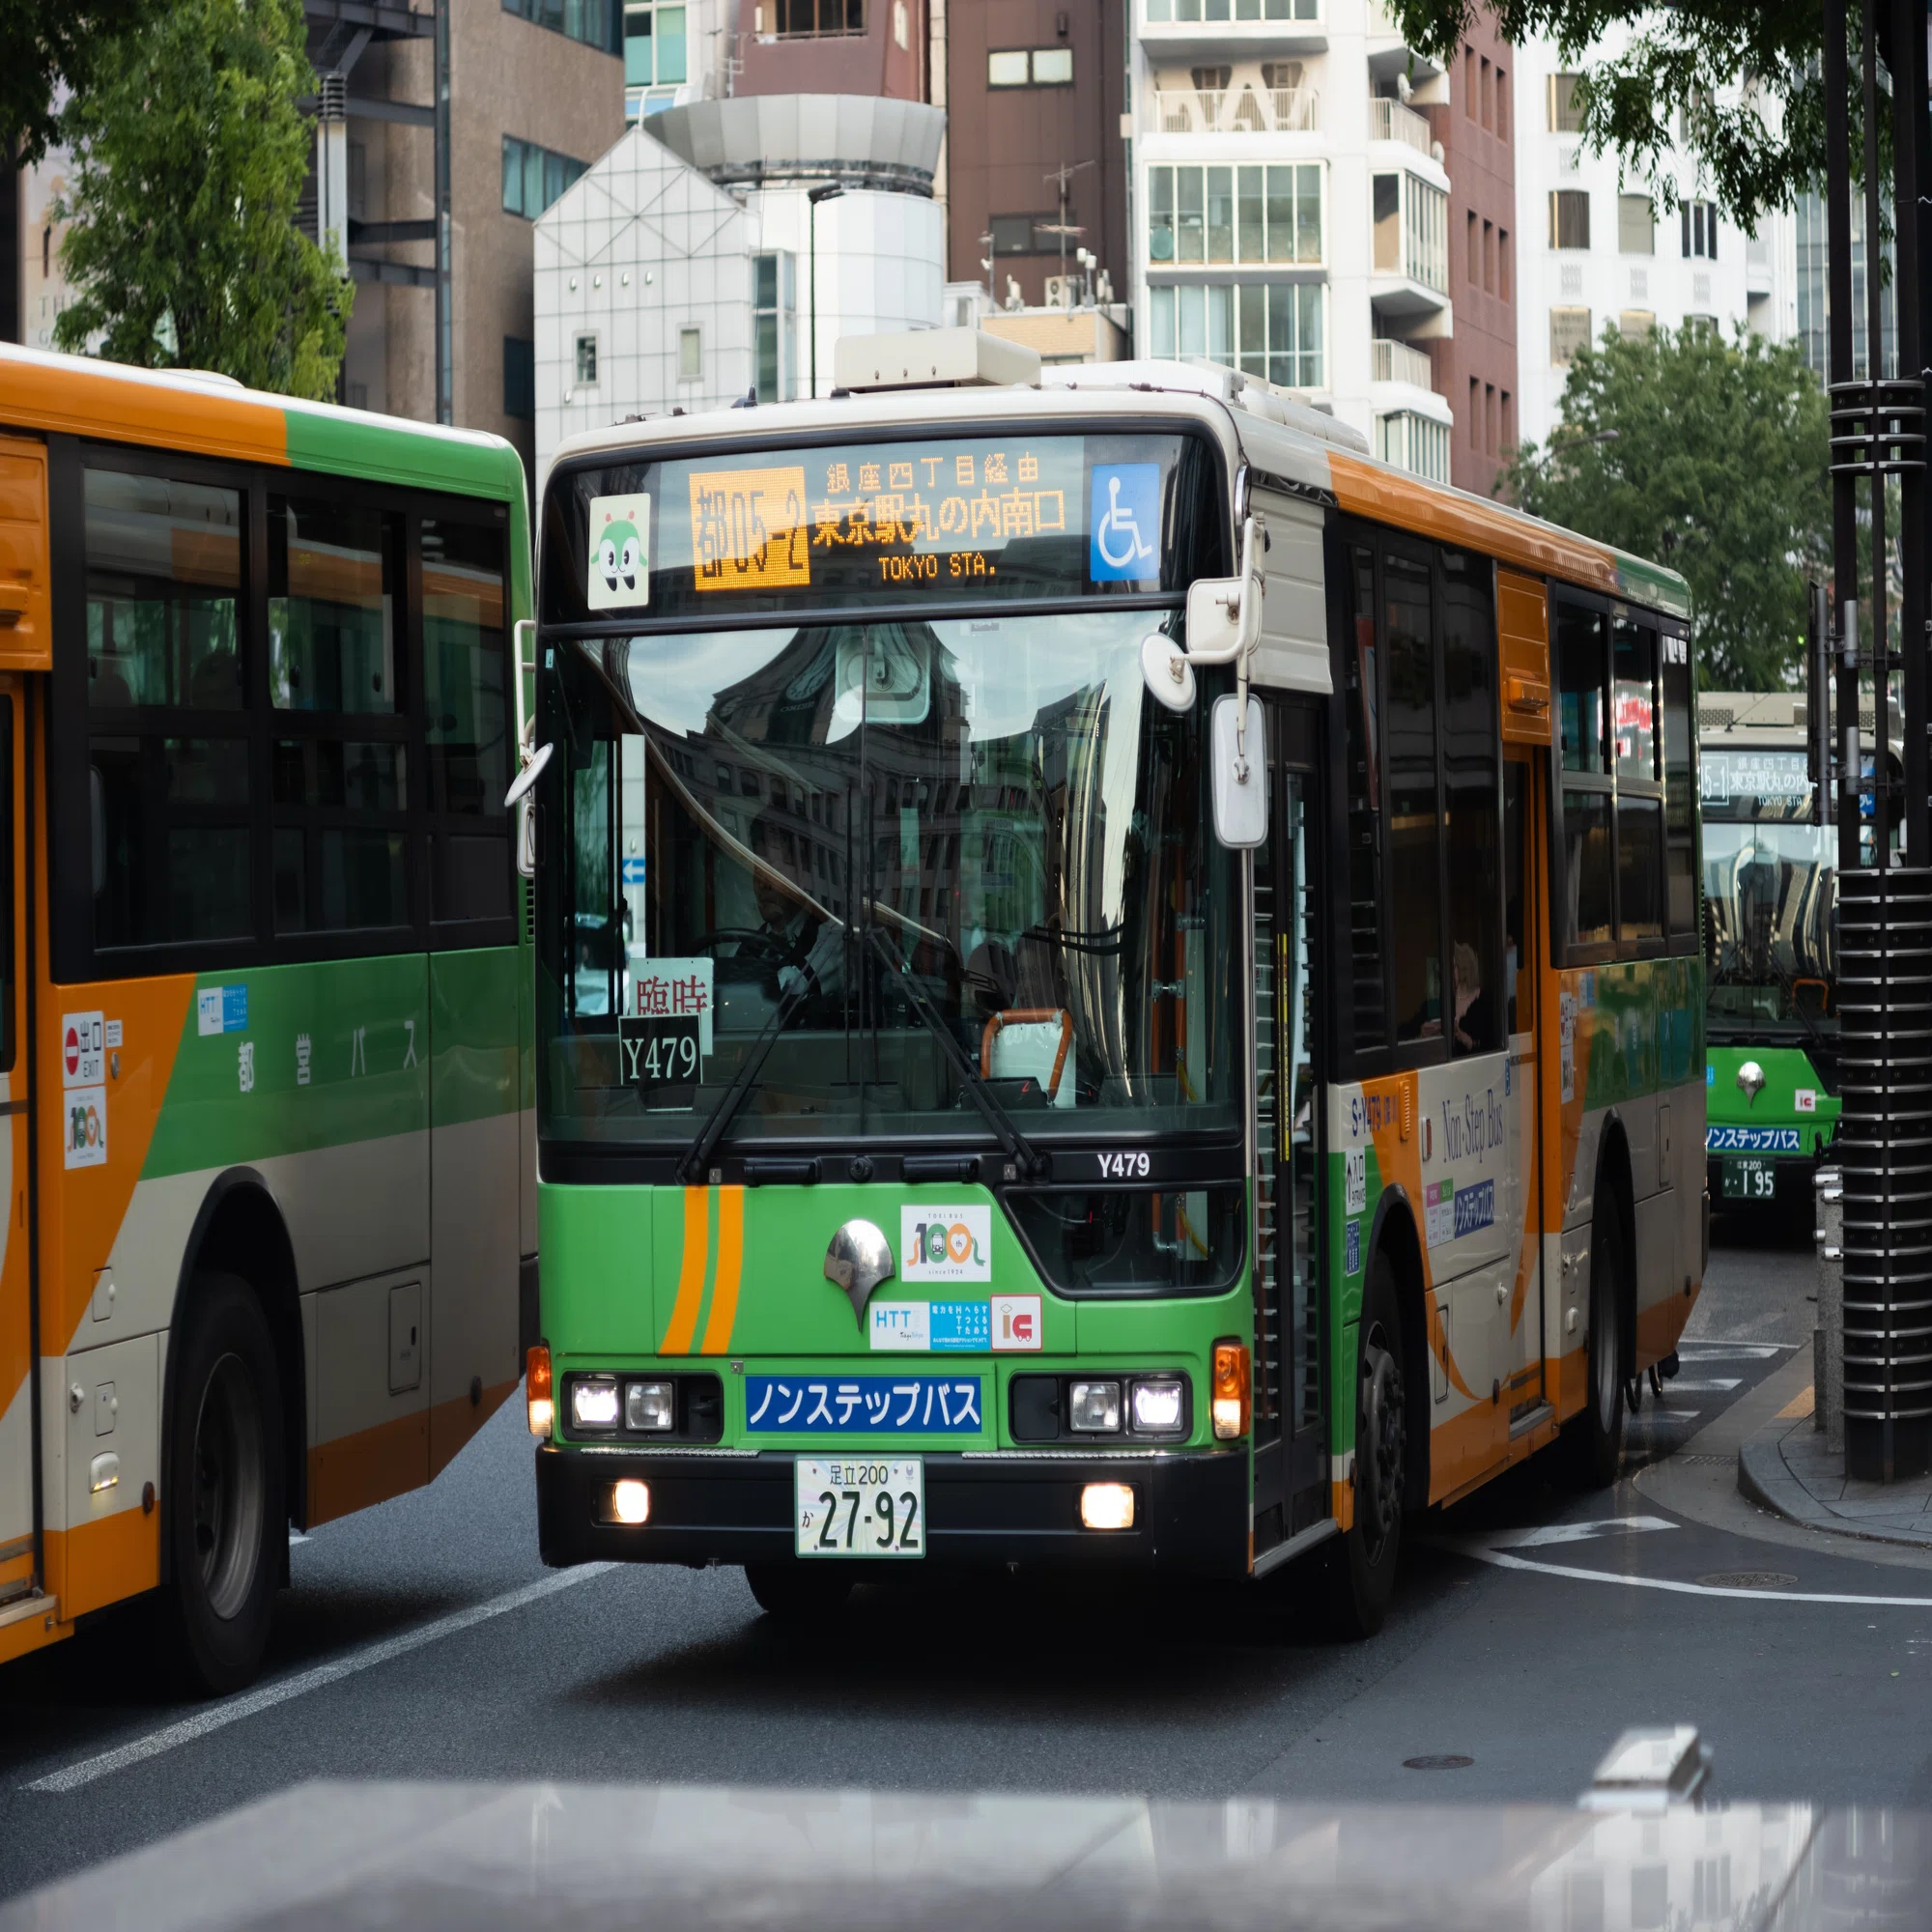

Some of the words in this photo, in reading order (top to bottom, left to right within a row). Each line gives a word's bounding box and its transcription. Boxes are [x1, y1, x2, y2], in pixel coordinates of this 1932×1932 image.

[827, 451, 1038, 494] 銀座四丁目経由
[696, 485, 804, 578] 都05-2
[810, 486, 1065, 548] 東京駅丸の内南口
[878, 554, 938, 581] TOKYO
[949, 552, 996, 577] STA.
[1729, 771, 1818, 792] 東京駅丸の内
[1758, 795, 1783, 807] TOKYO
[79, 1020, 102, 1054] 出口
[622, 1036, 696, 1079] Y479
[1487, 1088, 1503, 1149] Bus
[1706, 1128, 1800, 1150] ノンステップバス
[1097, 1152, 1151, 1178] Y479
[1455, 1182, 1494, 1233] ノンステップバス
[875, 1310, 911, 1328] HTT
[750, 1382, 980, 1426] ノンステップバス
[830, 1464, 889, 1486] 足立200
[802, 1510, 814, 1528] か
[818, 1491, 919, 1548] 27-92
